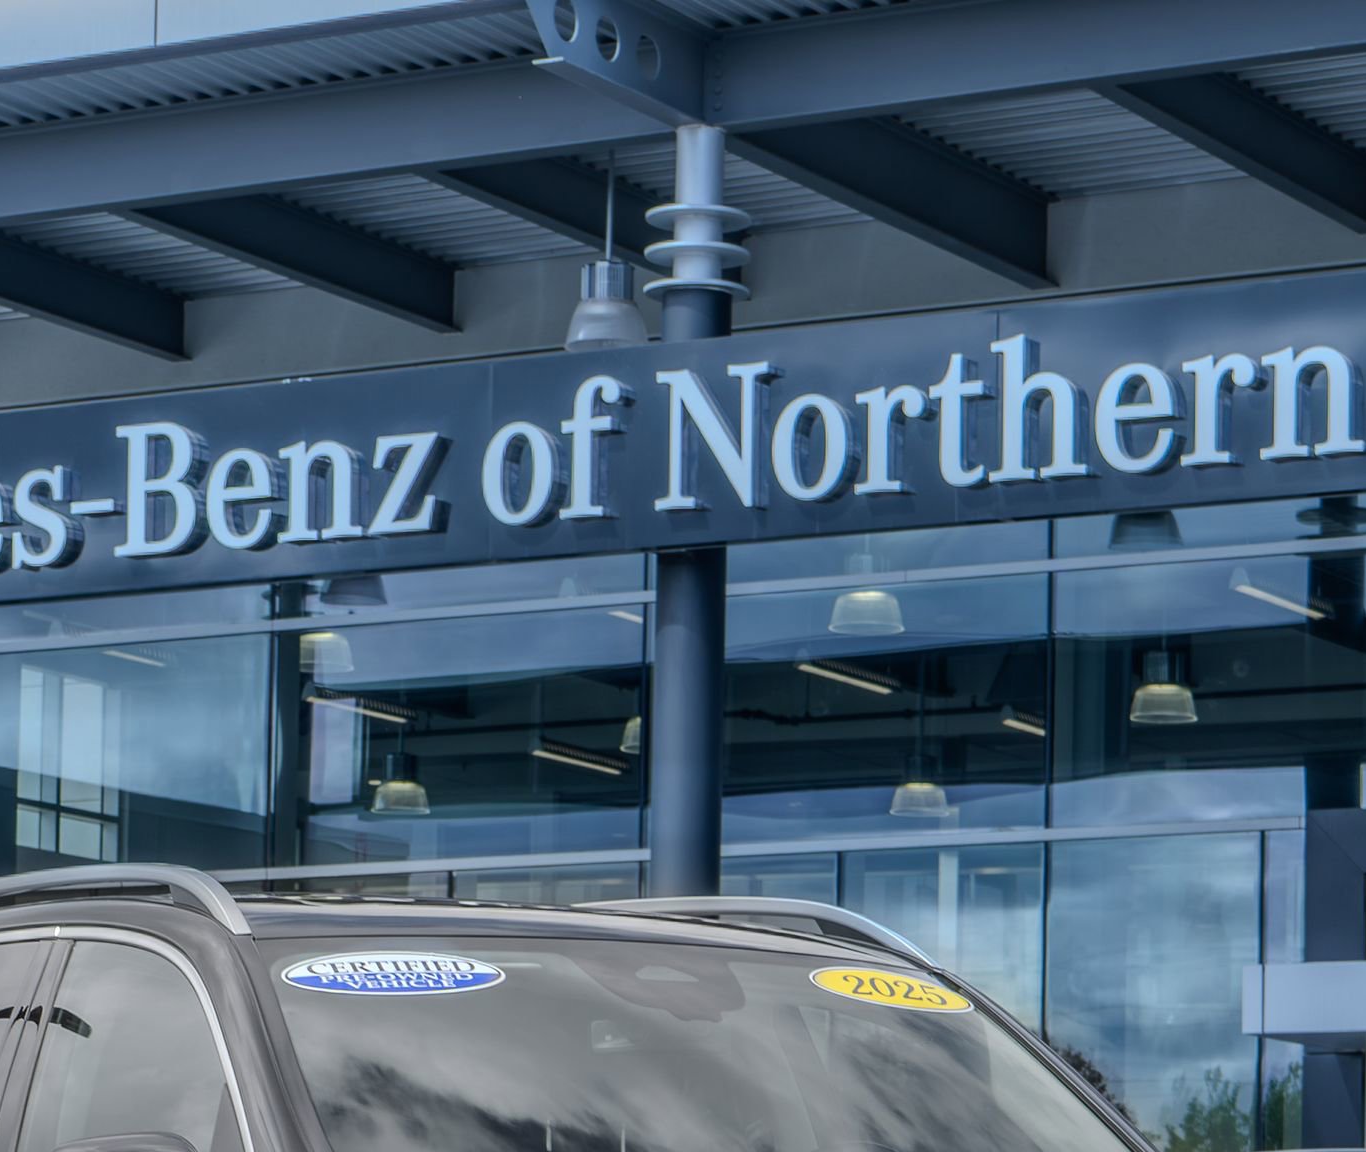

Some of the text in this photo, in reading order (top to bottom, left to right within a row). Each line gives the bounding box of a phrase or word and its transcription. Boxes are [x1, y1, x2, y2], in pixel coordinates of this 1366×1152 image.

[482, 374, 629, 524] of
[307, 959, 476, 975] CERTIFIED
[318, 971, 474, 984] PRE-OWNED
[346, 977, 458, 989] VEHICLE
[842, 974, 948, 1006] 2025
